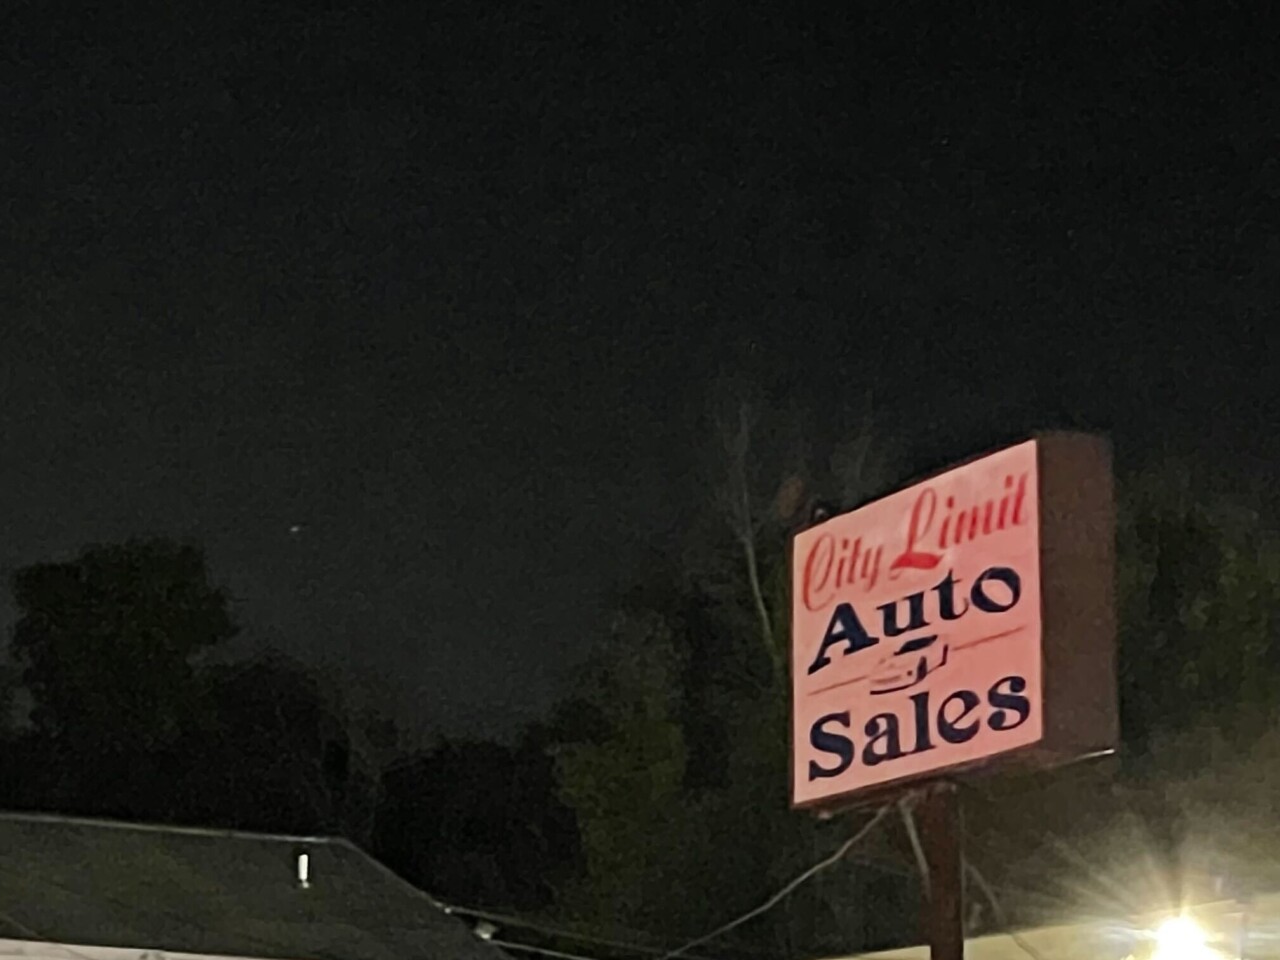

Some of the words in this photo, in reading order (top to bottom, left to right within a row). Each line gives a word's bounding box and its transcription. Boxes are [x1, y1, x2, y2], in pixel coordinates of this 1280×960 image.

[802, 532, 884, 612] City
[889, 474, 1029, 580] Limit
[807, 566, 1022, 676] Auto
[807, 676, 1031, 782] Sales
